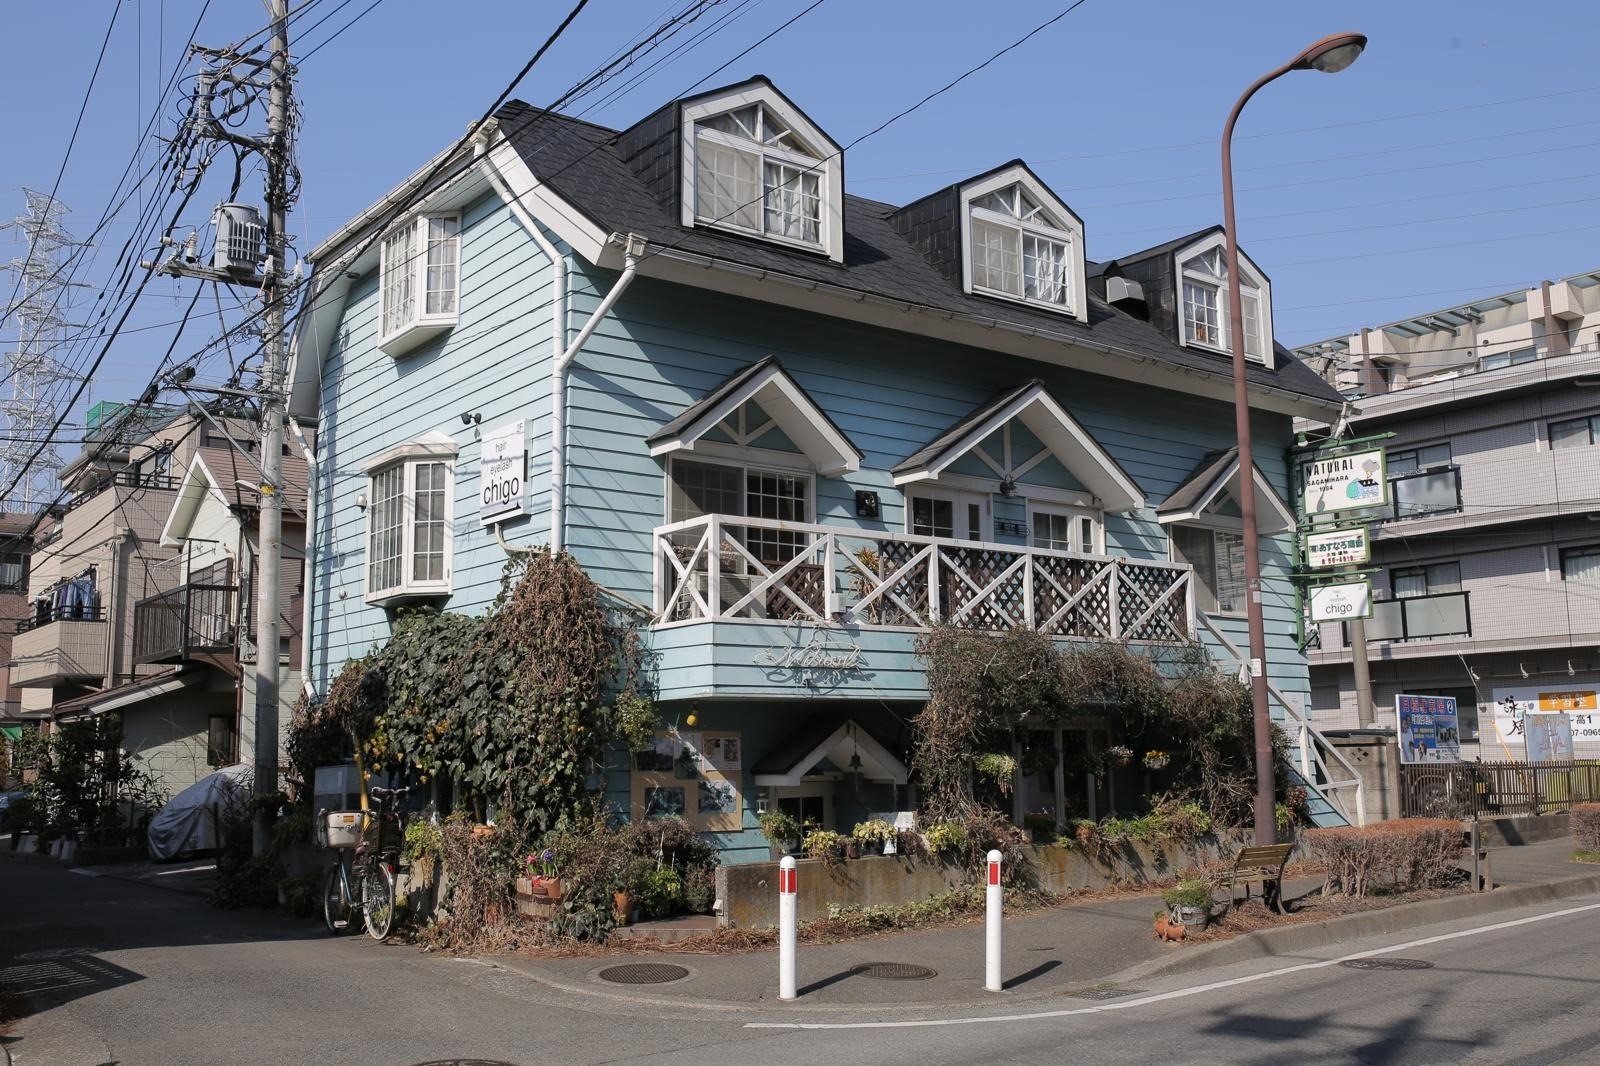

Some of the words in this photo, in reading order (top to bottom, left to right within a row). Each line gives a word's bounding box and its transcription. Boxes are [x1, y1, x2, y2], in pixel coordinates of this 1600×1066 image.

[495, 440, 507, 453] hair
[490, 459, 513, 476] eyelash
[1305, 458, 1354, 477] NATURAL
[1307, 475, 1349, 487] SAGAMIHARA
[483, 476, 519, 505] chigo
[1326, 602, 1353, 616] chigo
[1547, 693, 1588, 708] 学習塾
